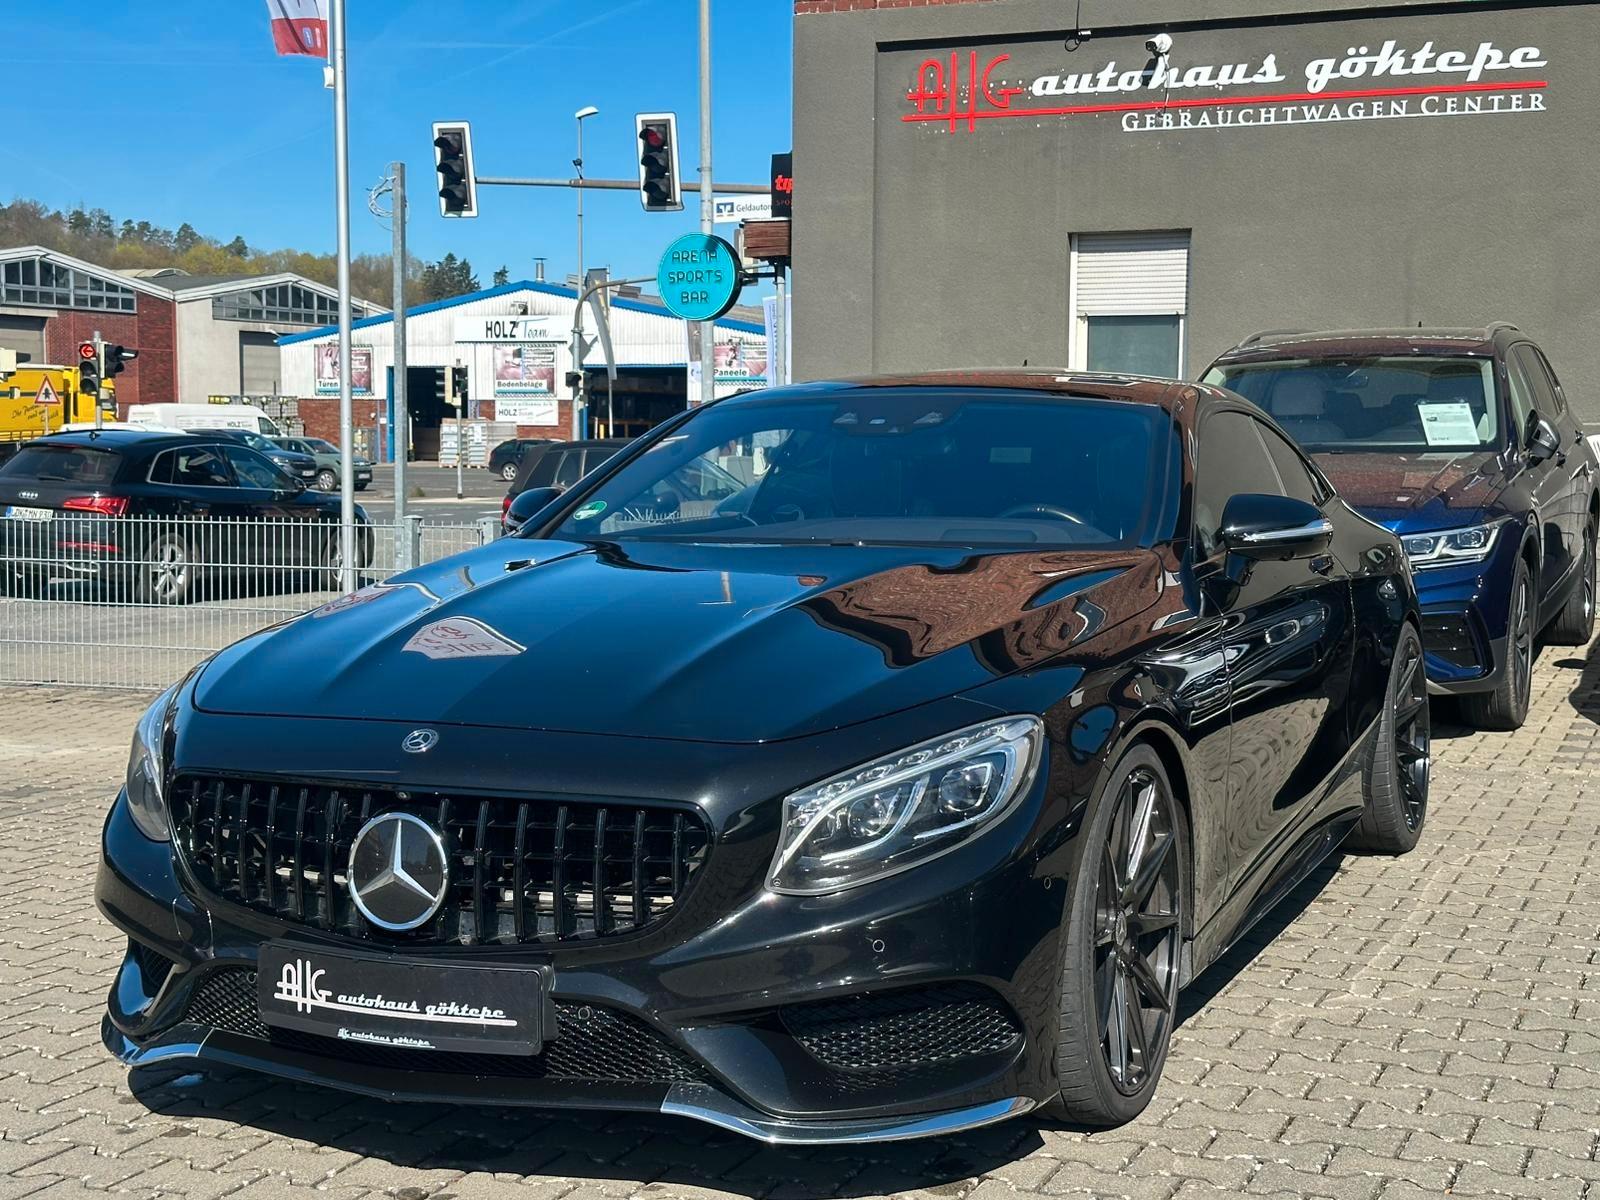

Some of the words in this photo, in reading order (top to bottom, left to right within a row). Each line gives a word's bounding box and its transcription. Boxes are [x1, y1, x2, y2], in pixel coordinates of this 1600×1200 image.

[1031, 53, 1286, 97] autohaus
[1304, 40, 1548, 94] göktepe
[1121, 100, 1408, 131] GEBRAUCHTWAGEN
[1420, 93, 1547, 116] CENTER
[671, 248, 718, 263] ARENA
[667, 269, 723, 284] SPORTS
[680, 290, 709, 304] BAR
[485, 320, 516, 339] HOLZ
[517, 317, 550, 338] Team
[713, 368, 747, 376] Paneele
[498, 408, 517, 416] HOLZ
[276, 958, 333, 1014] AHG
[337, 993, 420, 1012] autohaus
[425, 1001, 507, 1020] göktepe
[351, 1031, 391, 1042] autohaus
